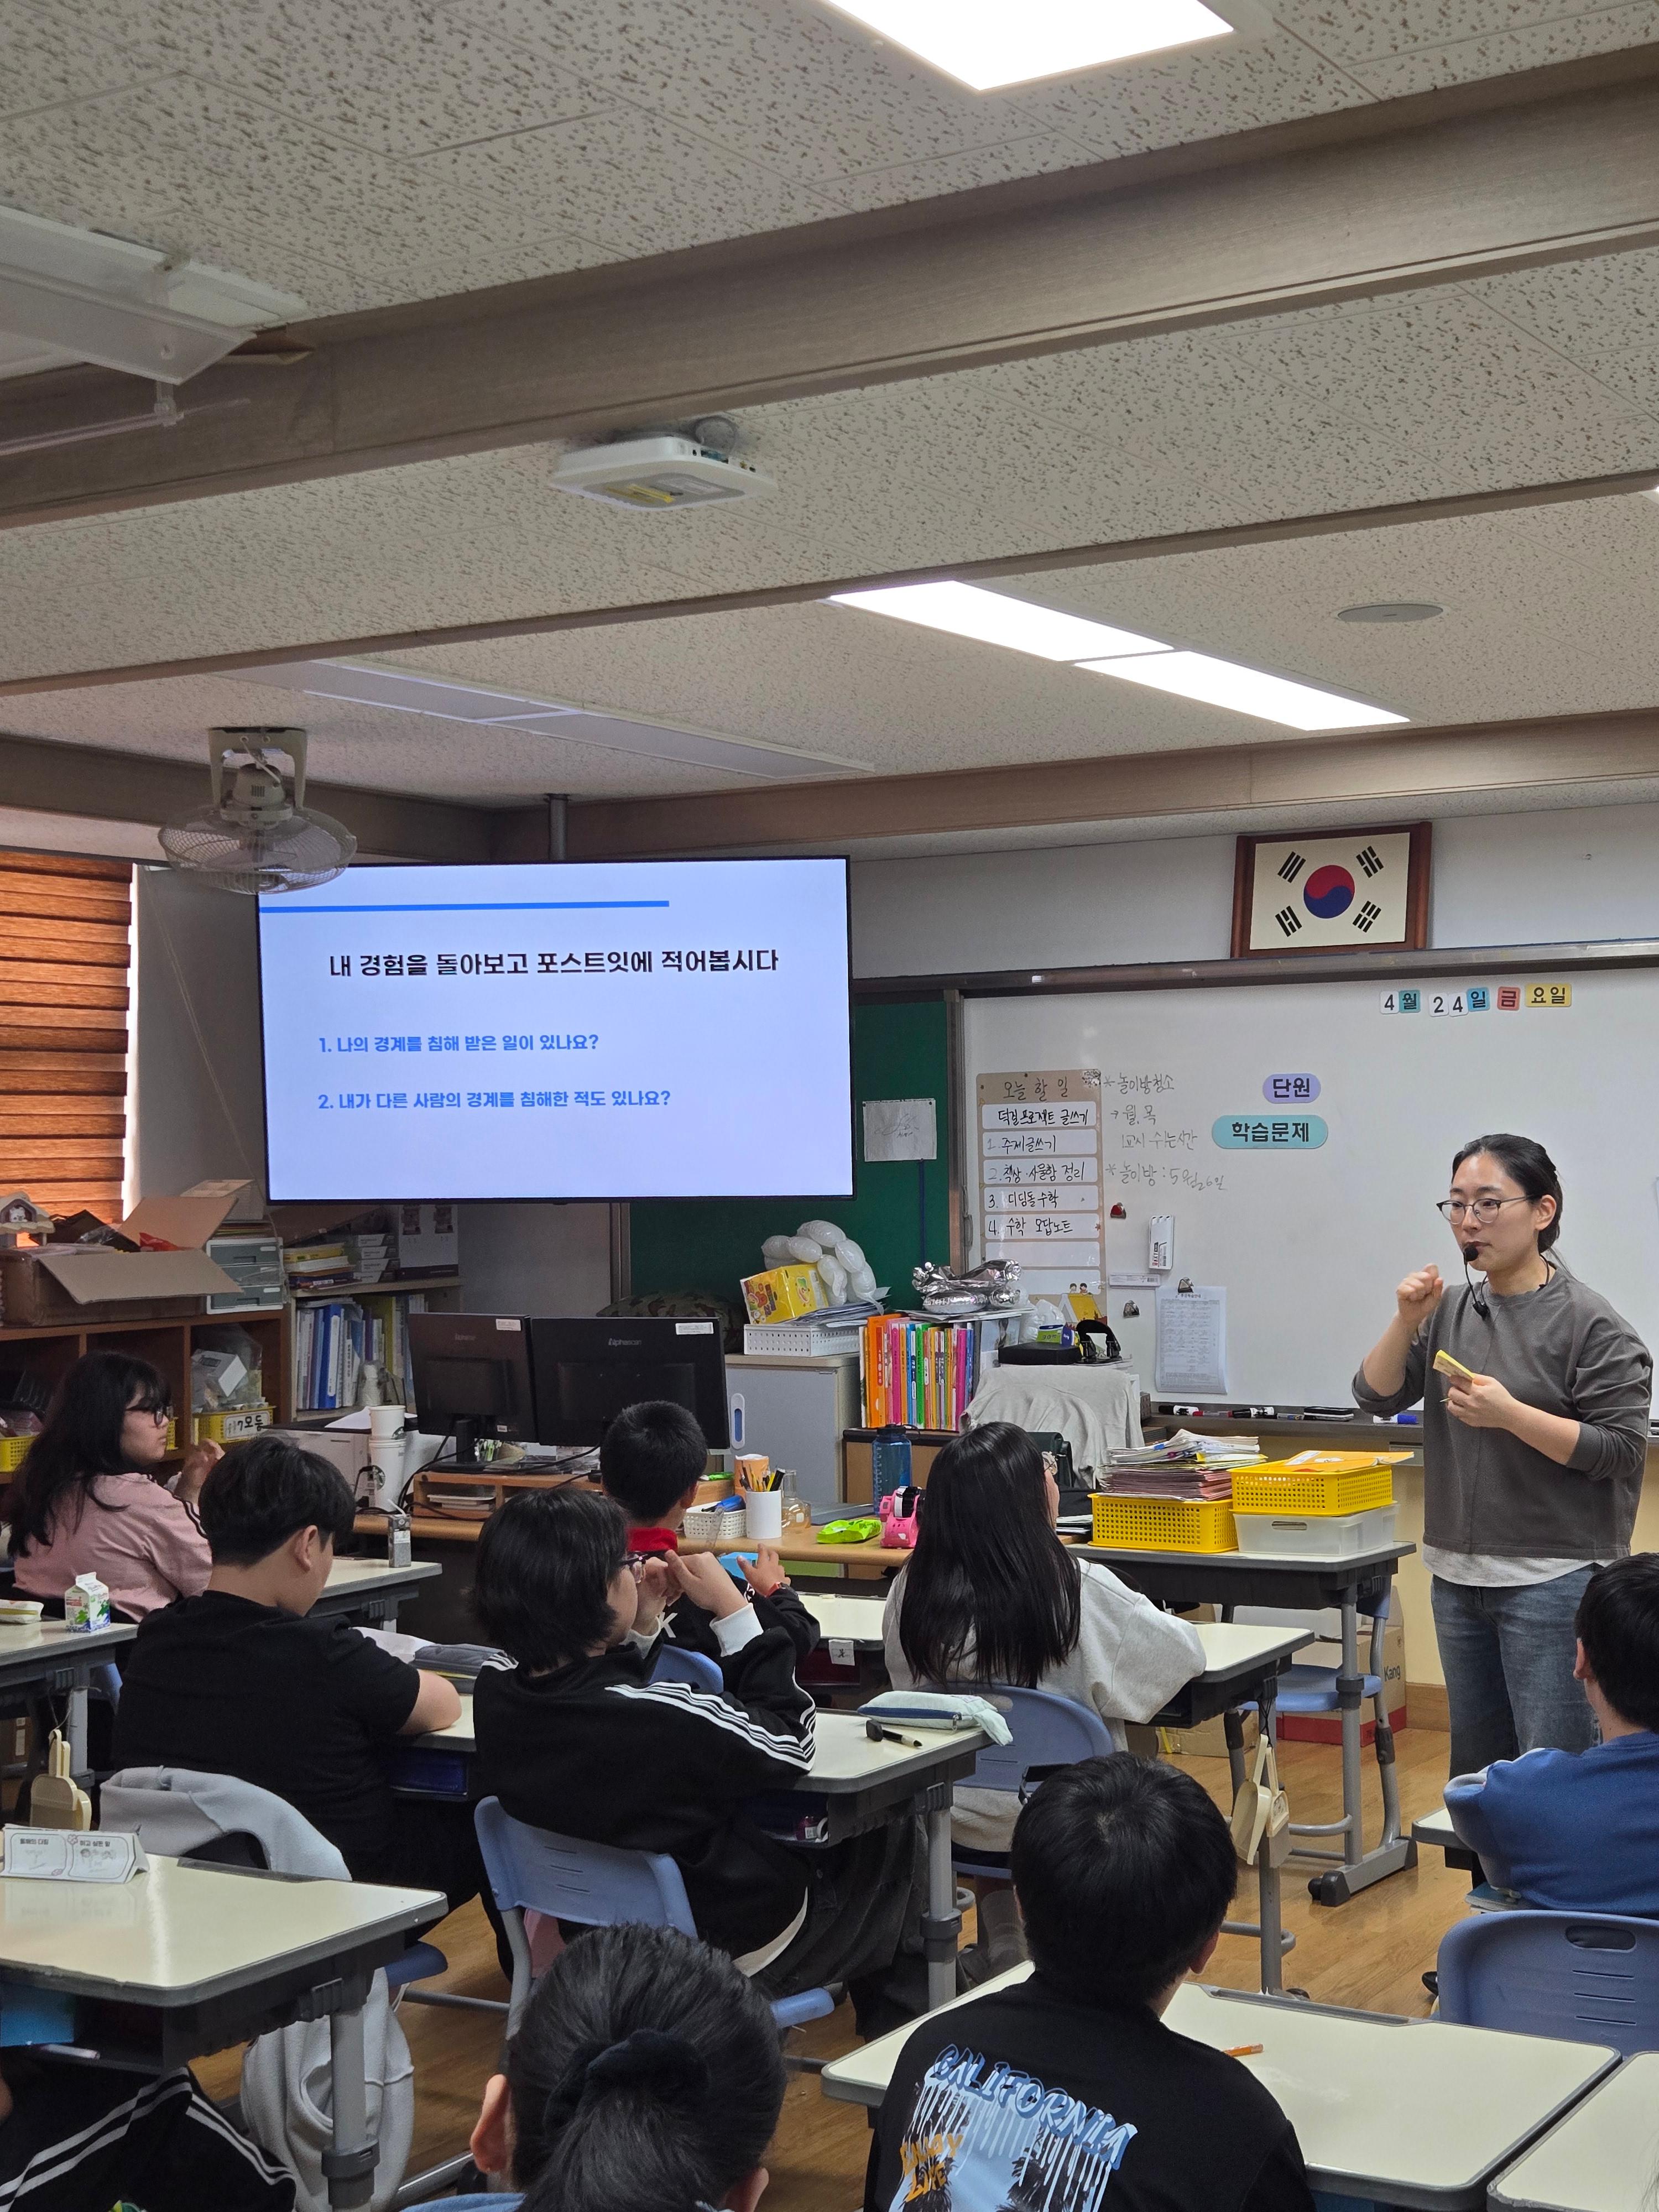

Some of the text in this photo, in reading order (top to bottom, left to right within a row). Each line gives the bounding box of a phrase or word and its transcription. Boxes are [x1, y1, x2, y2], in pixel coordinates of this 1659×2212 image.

[330, 949, 779, 977] 내 경험을 돌아보고 포스트잇에 적어봅시다
[1384, 993, 1417, 1010] 4월
[319, 1034, 599, 1052] 1. 나의 경계를 침해 받은 일이 있나요?
[1003, 1076, 1068, 1102] 오늘 할 일
[1273, 1077, 1310, 1098] 단원
[318, 1090, 671, 1109] 2. 내가 다른 사람의 경계를 침해한 적도 있나요?
[1060, 1109, 1088, 1126] 글쓰기
[1143, 1105, 1156, 1125] 목
[1232, 1122, 1310, 1142] 학습문제
[1061, 1161, 1084, 1182] 정리
[1006, 1217, 1027, 1237] 수학
[1035, 1217, 1073, 1237] 오답노트
[1384, 1665, 1401, 1682] Kang
[924, 2043, 1139, 2171] CALIFORNIA
